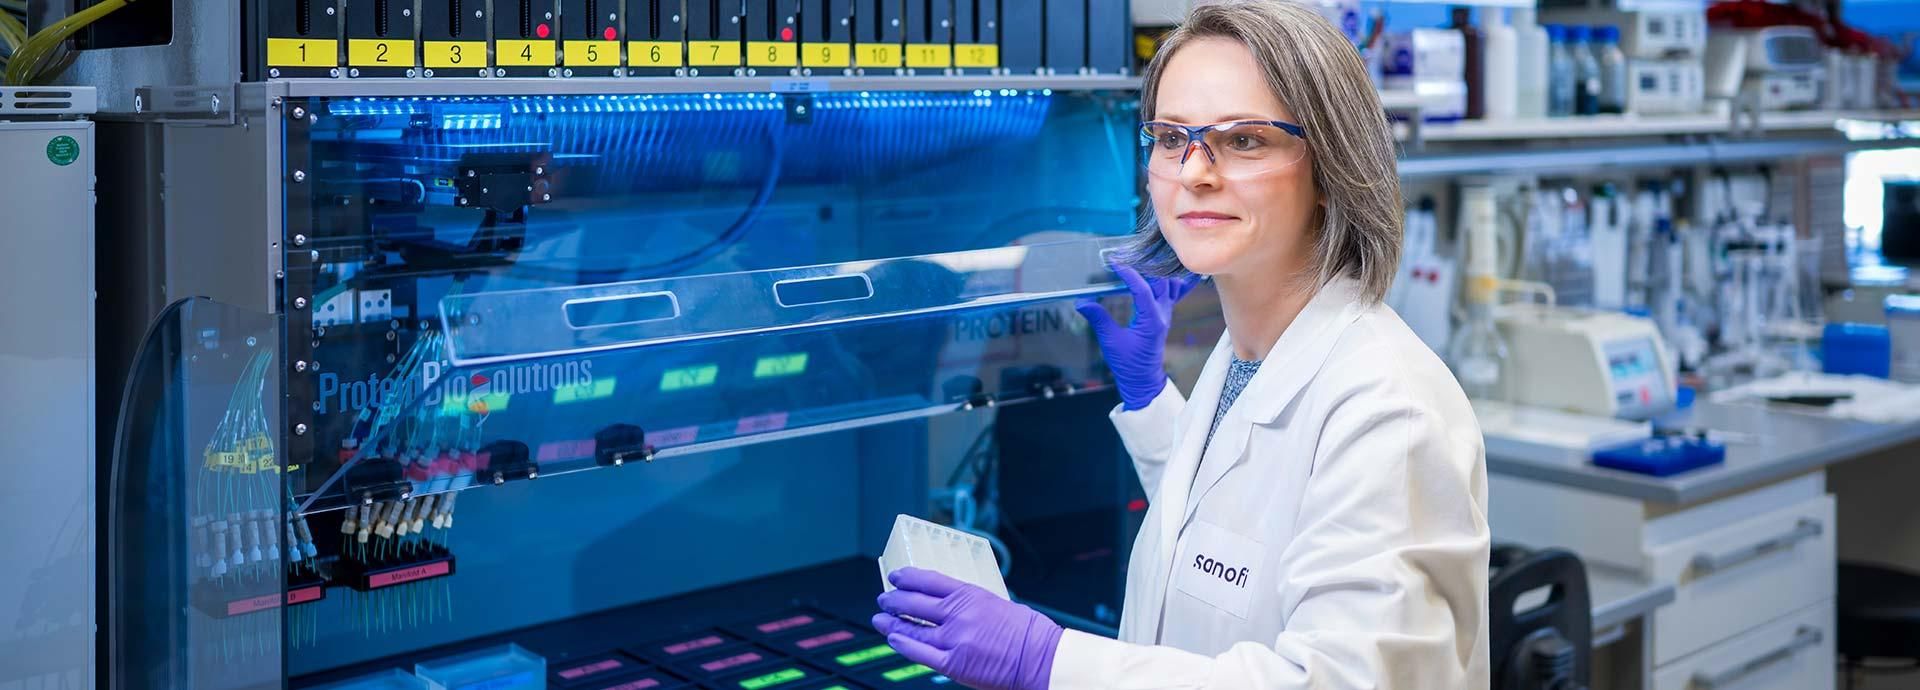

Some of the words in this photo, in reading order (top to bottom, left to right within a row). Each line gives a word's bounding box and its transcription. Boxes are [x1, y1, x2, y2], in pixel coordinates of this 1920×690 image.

[298, 43, 306, 62] 1
[376, 43, 388, 63] 2
[450, 44, 462, 64] 3
[520, 43, 532, 62] 4
[587, 44, 598, 62] 5
[650, 45, 661, 63] 6
[709, 45, 720, 61] 7
[767, 45, 778, 62] 8
[821, 46, 831, 63] 9
[871, 47, 888, 63] 10
[921, 48, 936, 63] 11
[969, 48, 986, 63] 12
[954, 308, 1063, 342] PROTEIN
[223, 454, 235, 465] 19
[1193, 553, 1250, 589] sanofi
